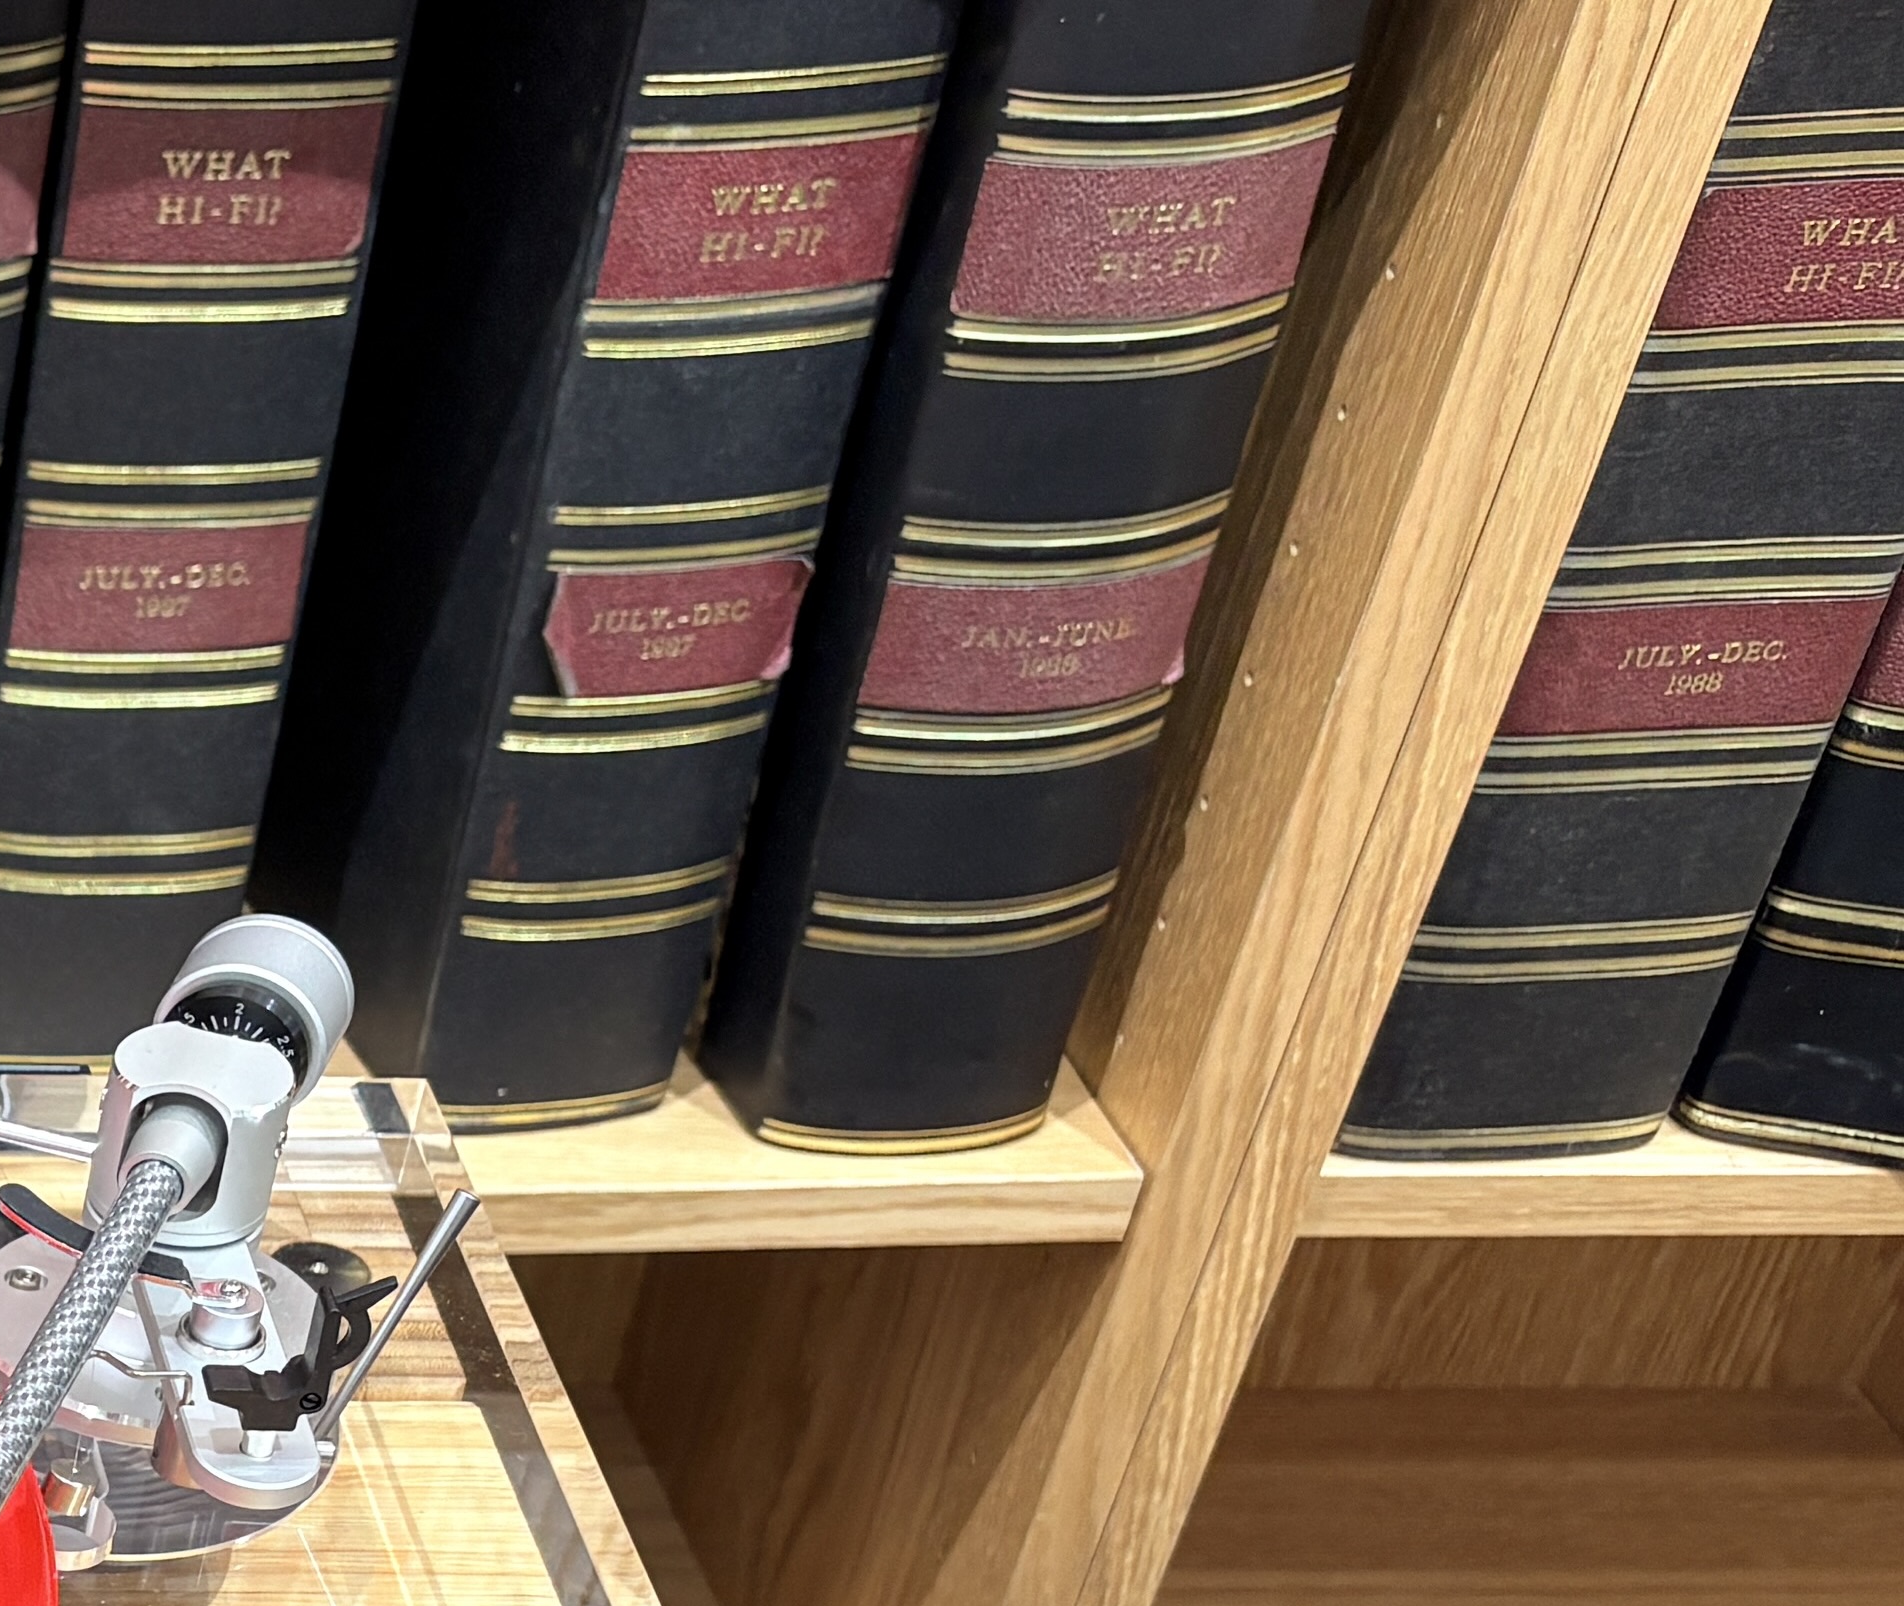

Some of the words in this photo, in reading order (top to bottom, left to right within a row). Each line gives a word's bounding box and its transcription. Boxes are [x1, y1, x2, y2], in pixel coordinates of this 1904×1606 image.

[162, 150, 291, 181] WHAT
[156, 193, 283, 226] HI-FI?
[710, 178, 837, 219] WHAT
[1106, 196, 1237, 236] WHAT
[1663, 671, 1723, 696] 1988
[234, 1003, 244, 1015] 2
